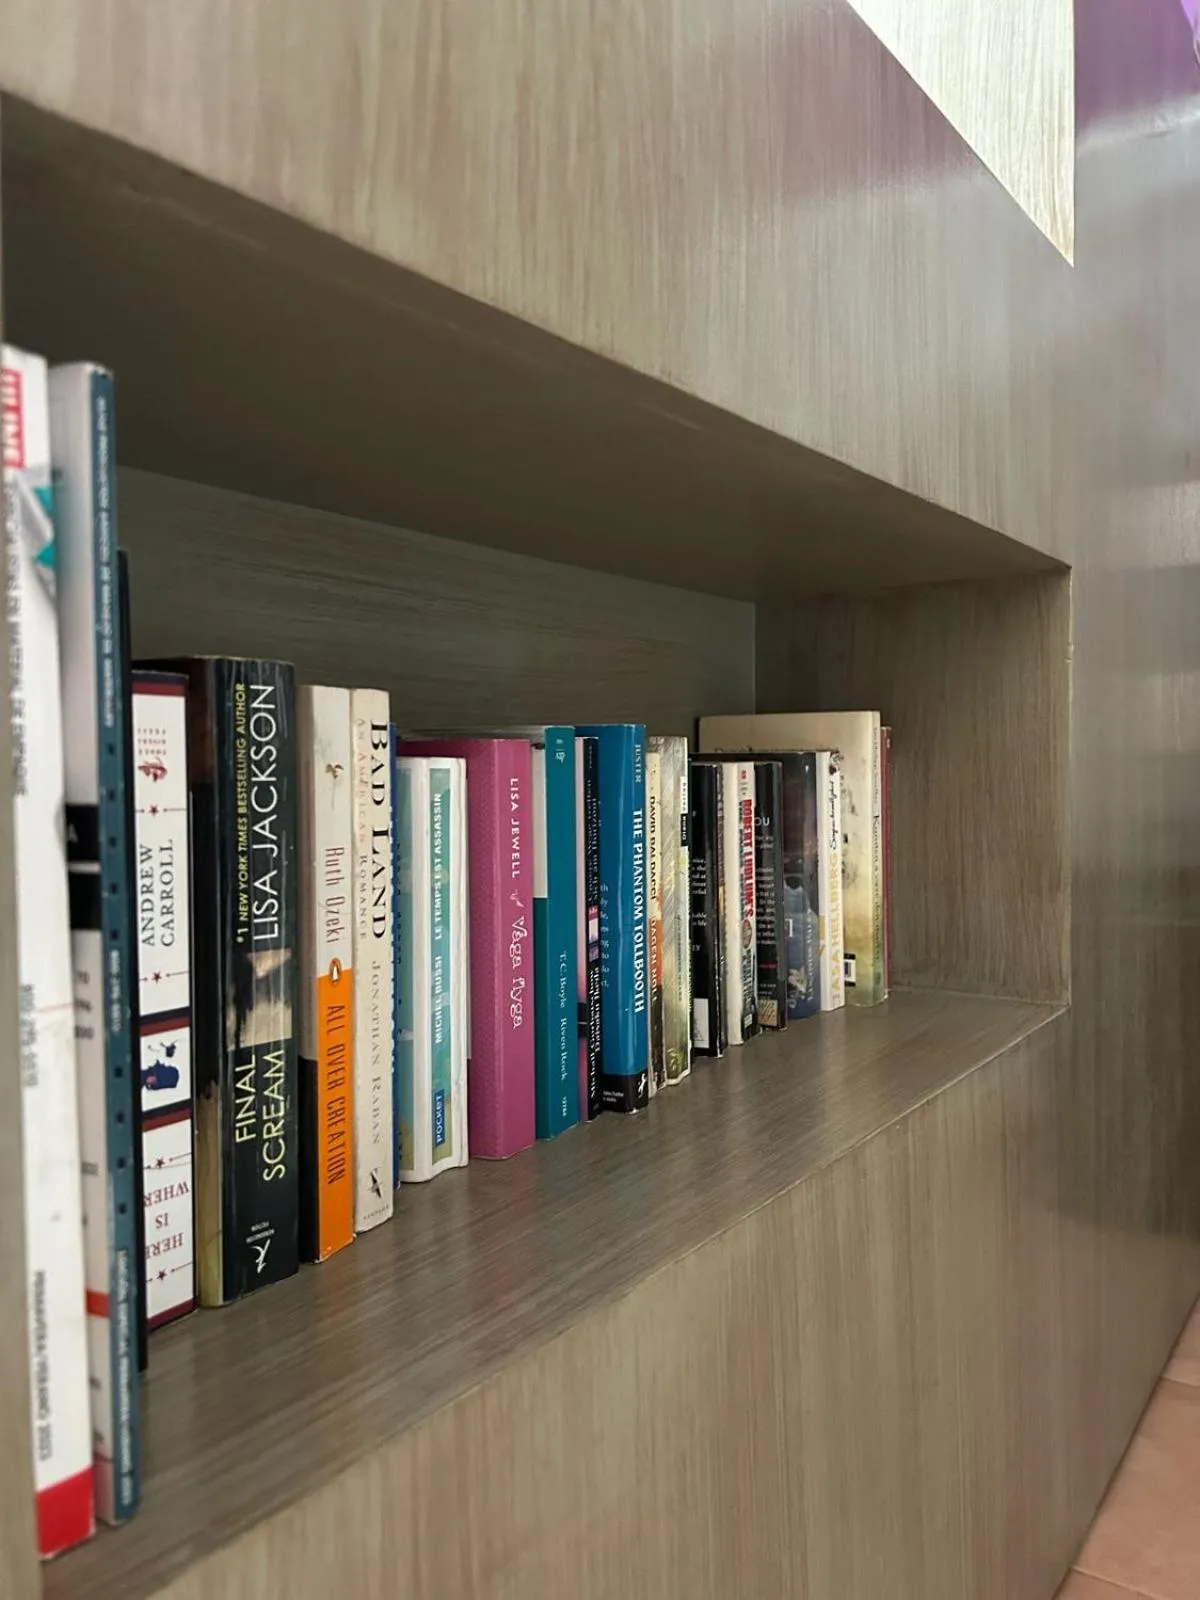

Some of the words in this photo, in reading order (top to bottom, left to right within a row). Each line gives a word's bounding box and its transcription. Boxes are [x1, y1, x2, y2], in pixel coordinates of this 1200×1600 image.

[235, 684, 246, 735] AUTHOR
[236, 737, 248, 814] BESTSELLING
[249, 684, 278, 858] JACKSON
[371, 719, 388, 806] BAD
[509, 777, 519, 812] LISA
[649, 795, 657, 834] DAVID
[237, 818, 248, 852] TIMES
[433, 792, 443, 853] ASSASSIN
[633, 807, 644, 839] THE
[744, 799, 753, 849] ROBERT
[238, 856, 249, 890] YORK
[324, 846, 346, 887] Ruth
[433, 857, 443, 879] EST
[511, 817, 521, 879] JEWELL
[139, 843, 155, 947] ANDREW
[158, 839, 175, 948] CARROLL
[251, 870, 279, 940] LISA
[358, 855, 369, 941] ROMANCE
[371, 827, 390, 940] LAND
[433, 882, 443, 921] TEMPS
[633, 843, 645, 919] PHANTOM
[238, 893, 249, 921] NEW
[324, 896, 347, 945] Ozeki
[433, 922, 443, 940] LE
[433, 955, 443, 995] BUSSI
[558, 977, 568, 1009] Boyle
[633, 923, 646, 1013] TOLLBOOTH
[326, 1004, 346, 1034] ALL
[370, 959, 383, 1066] JONATHAN
[433, 999, 443, 1044] MICHEL
[560, 1017, 568, 1050] Riven
[326, 1046, 346, 1093] OVER
[560, 1051, 568, 1081] Rock
[235, 1054, 257, 1143] FINAL
[262, 1050, 286, 1182] SCREAM
[370, 1075, 383, 1145] RABAN
[435, 1094, 444, 1144] POCKET
[326, 1098, 347, 1186] CREATION
[155, 1212, 169, 1229] IS
